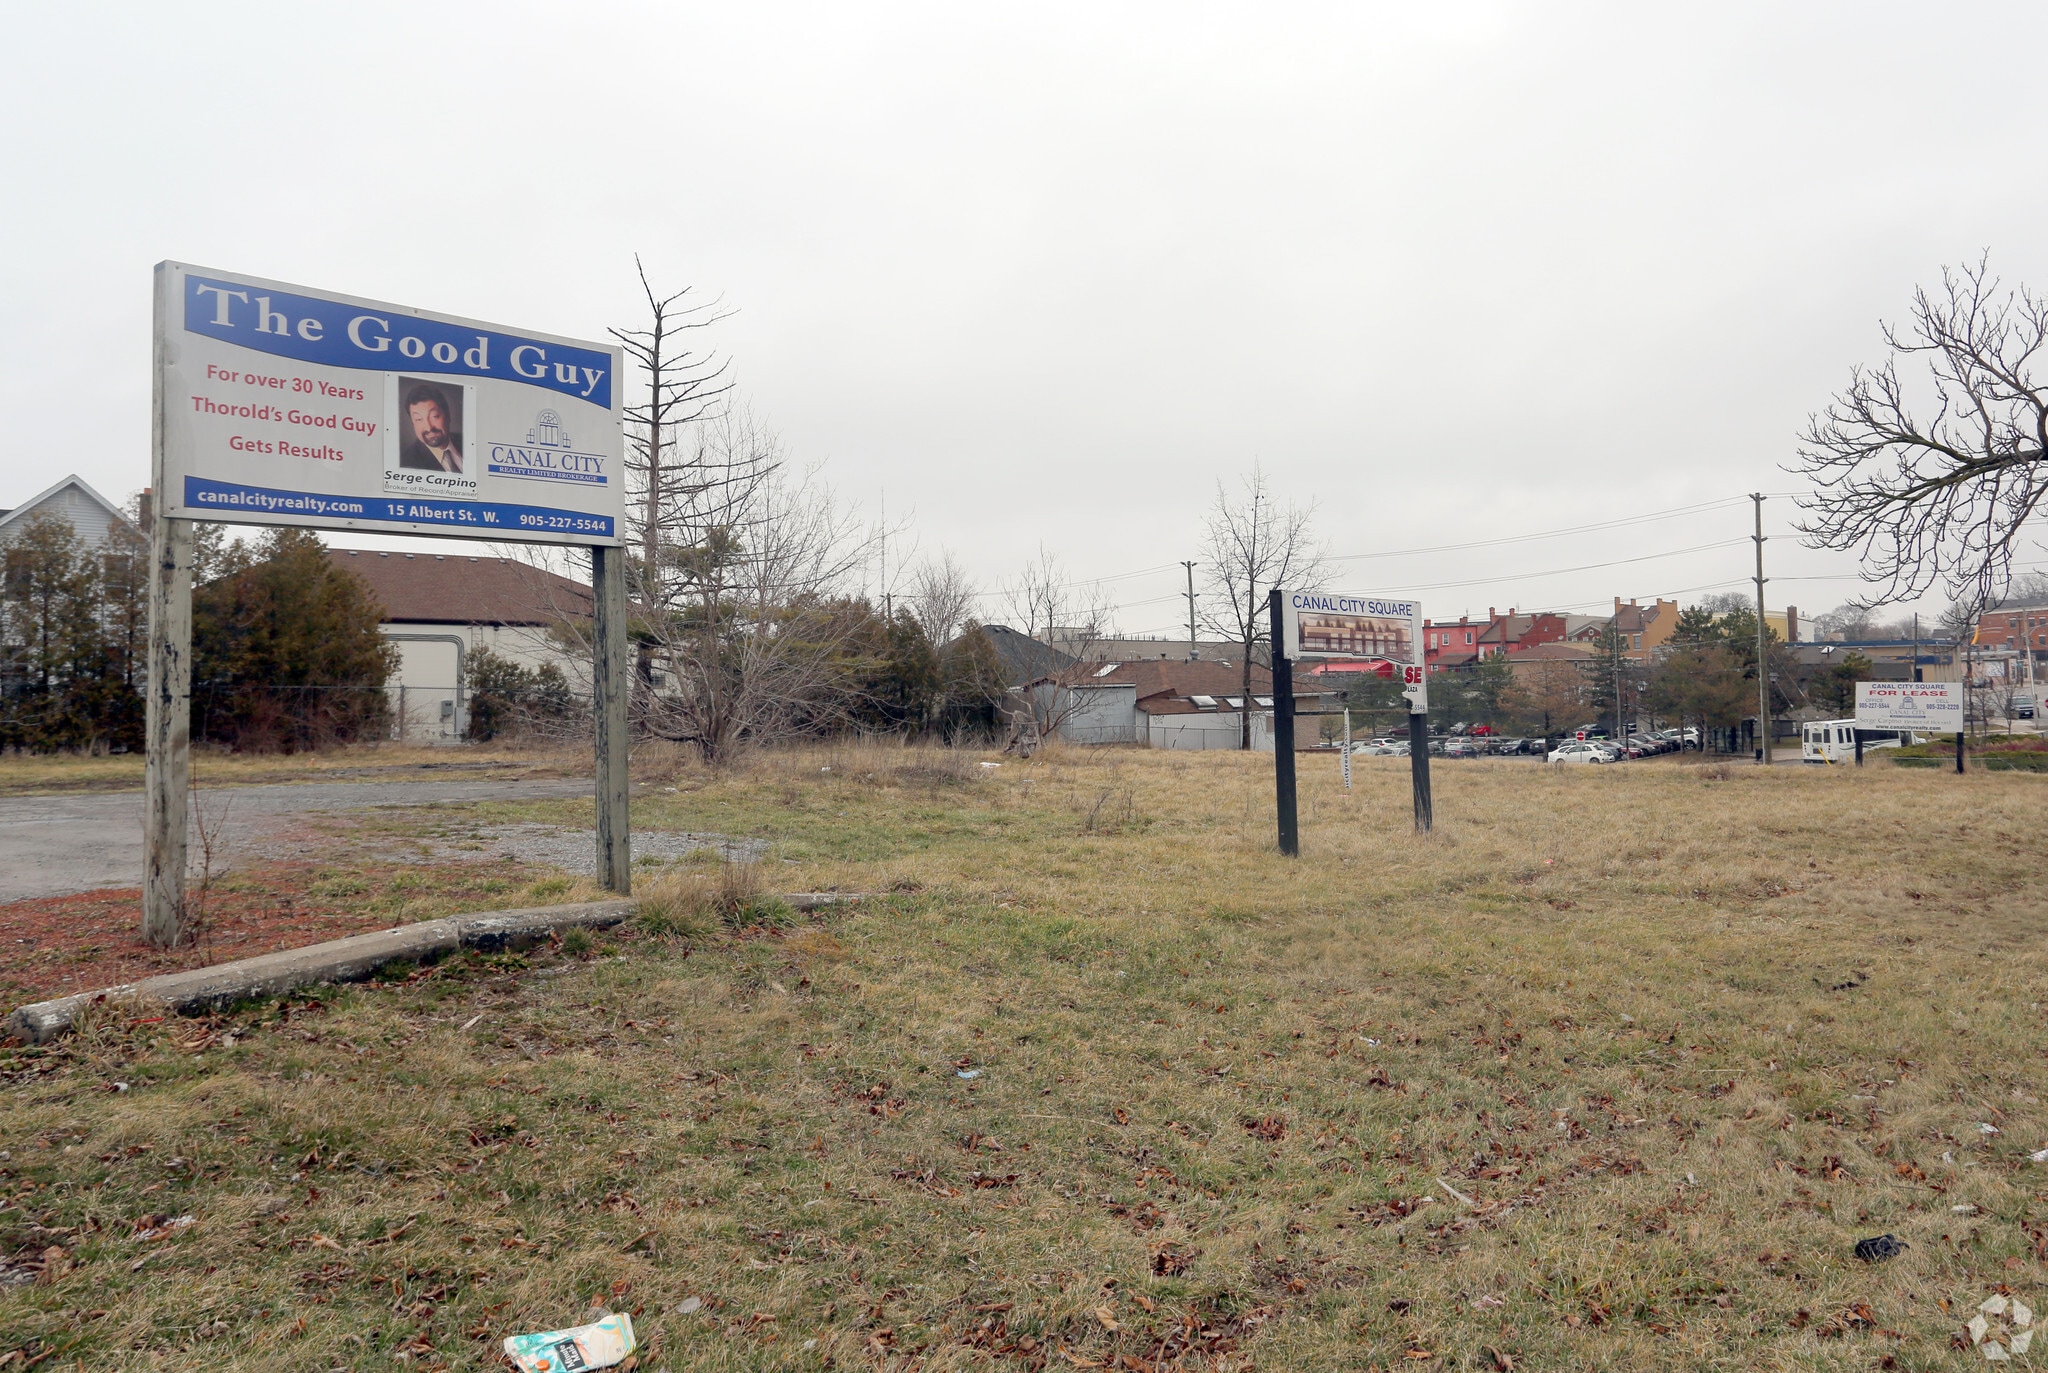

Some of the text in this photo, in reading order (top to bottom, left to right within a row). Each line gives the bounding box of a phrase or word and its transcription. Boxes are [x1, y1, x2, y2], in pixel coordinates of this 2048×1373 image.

[196, 283, 605, 398] The Good Guy
[207, 364, 364, 401] For over 30 Years
[191, 396, 376, 437] Thorold's Good Guy
[229, 436, 344, 461] Gets Results
[491, 446, 605, 474] CANAL CITY
[384, 470, 477, 488] Serge Carpino
[499, 466, 598, 482] REALTY LIMITED BROKERAGE
[197, 490, 363, 513] canalcityrealty.com
[418, 486, 478, 497] Record/Appraiser
[387, 504, 500, 523] 15 Albert St. W.
[520, 514, 606, 531] 905-227-5544
[1292, 595, 1413, 616] CANAL CITY SQUARE
[560, 1344, 575, 1368] Minute
[566, 1344, 580, 1362] Maid
